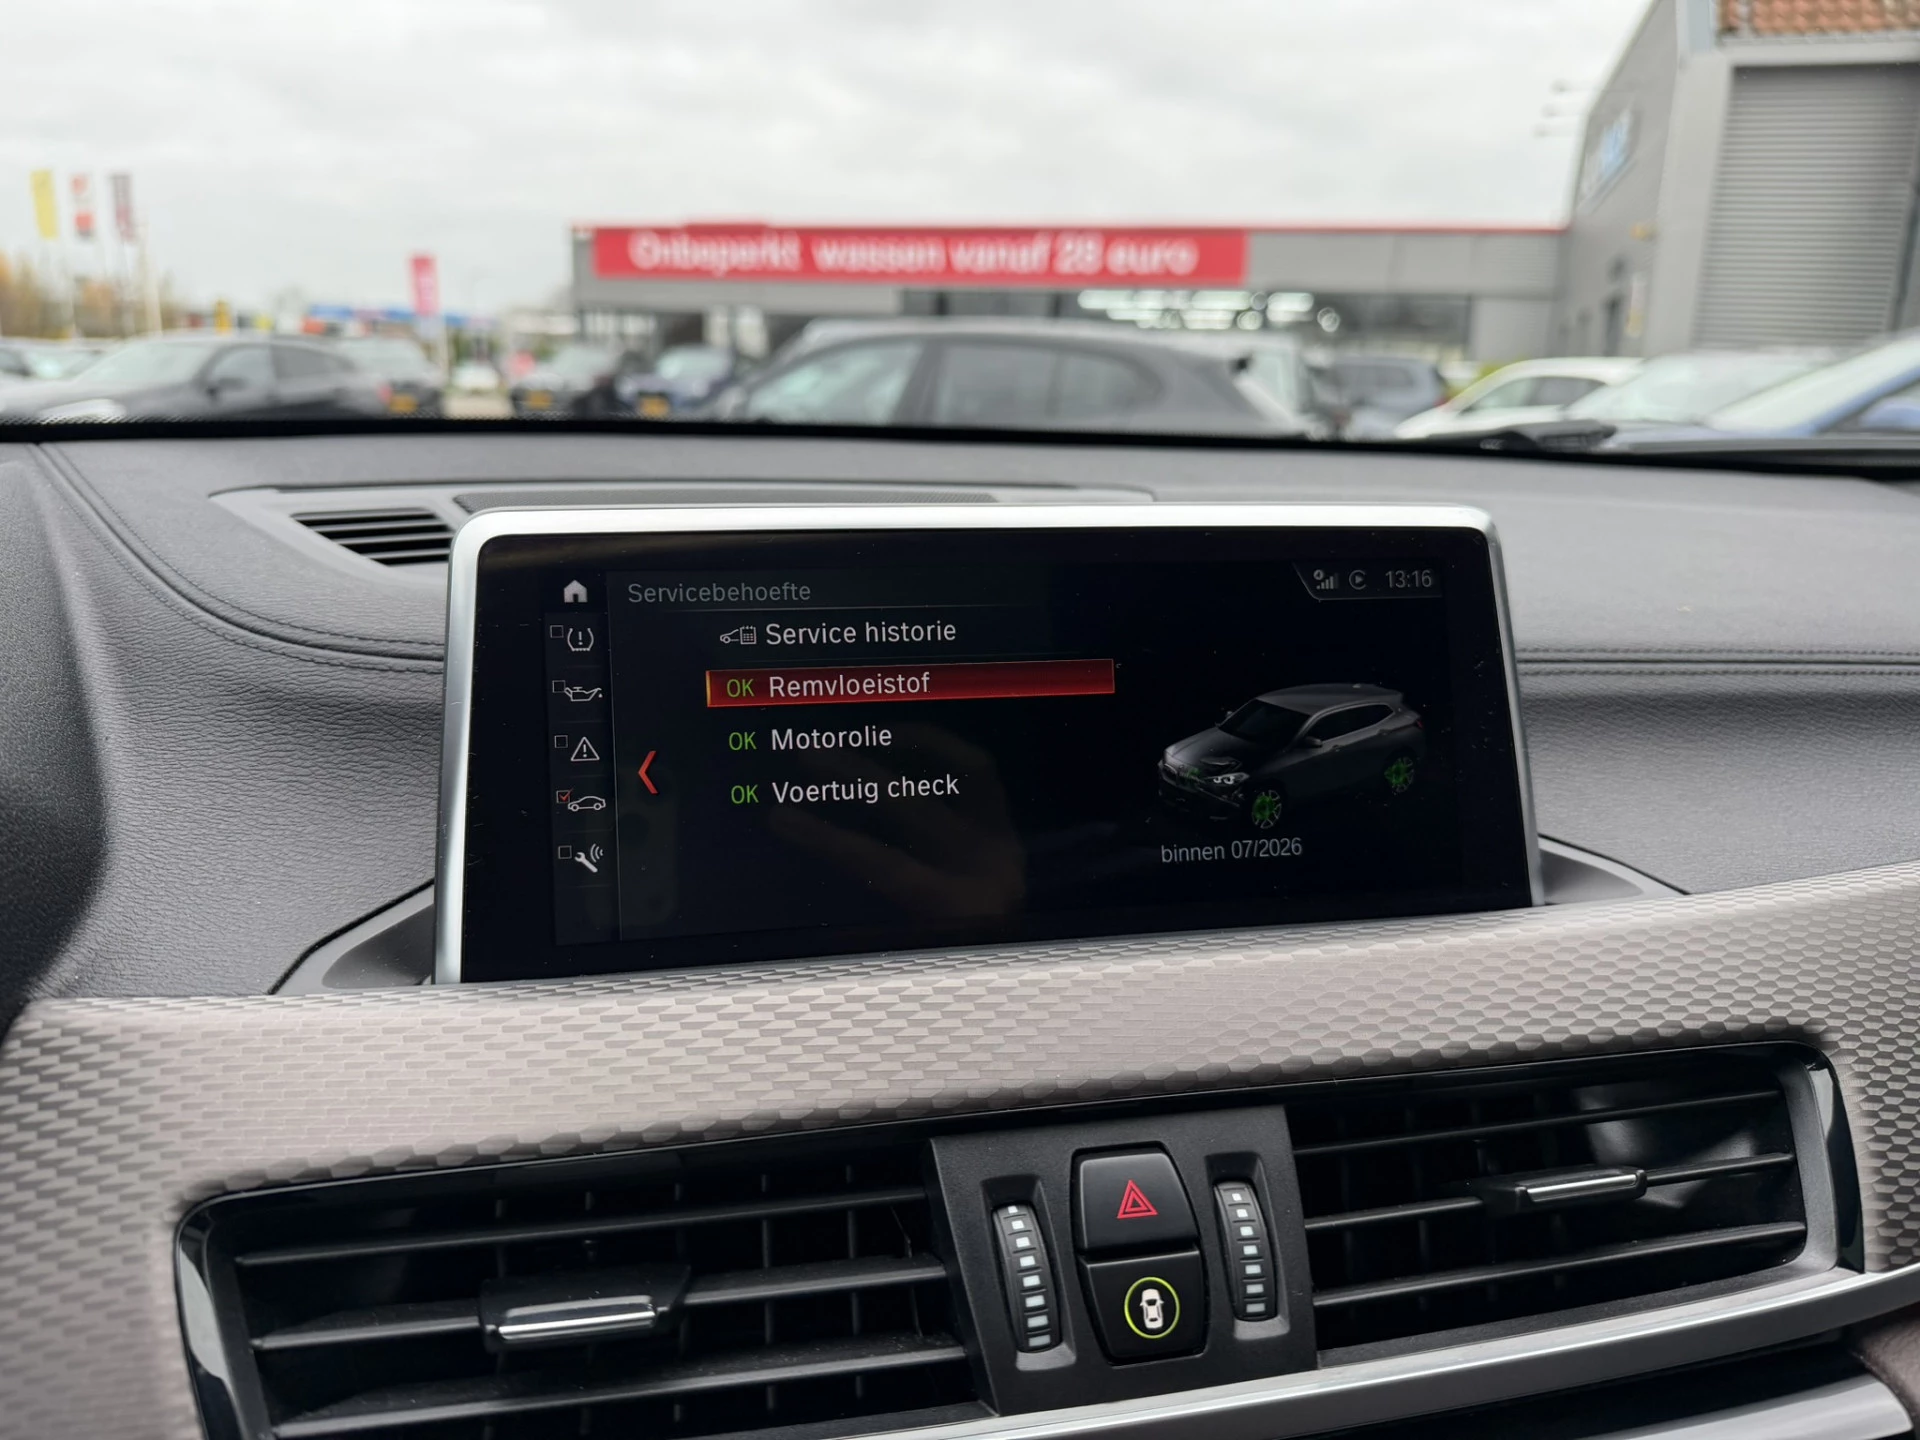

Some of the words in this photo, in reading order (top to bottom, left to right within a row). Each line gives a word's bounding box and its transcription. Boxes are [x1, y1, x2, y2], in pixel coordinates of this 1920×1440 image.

[811, 236, 946, 273] wassen
[949, 230, 1051, 274] vanaf
[1106, 238, 1198, 275] euro
[1385, 569, 1433, 588] 13:16
[627, 581, 812, 604] Servicebehoefte
[765, 621, 857, 646] Service
[865, 619, 957, 643] historie
[726, 677, 756, 699] OK
[768, 671, 931, 699] Remvloeistof
[728, 731, 758, 752] OK
[771, 724, 893, 752] Motorolie
[730, 784, 760, 806] OK
[772, 777, 880, 804] Voertuig
[887, 773, 960, 799] check
[1161, 844, 1226, 863] binnen
[1231, 837, 1303, 859] 07/2026
